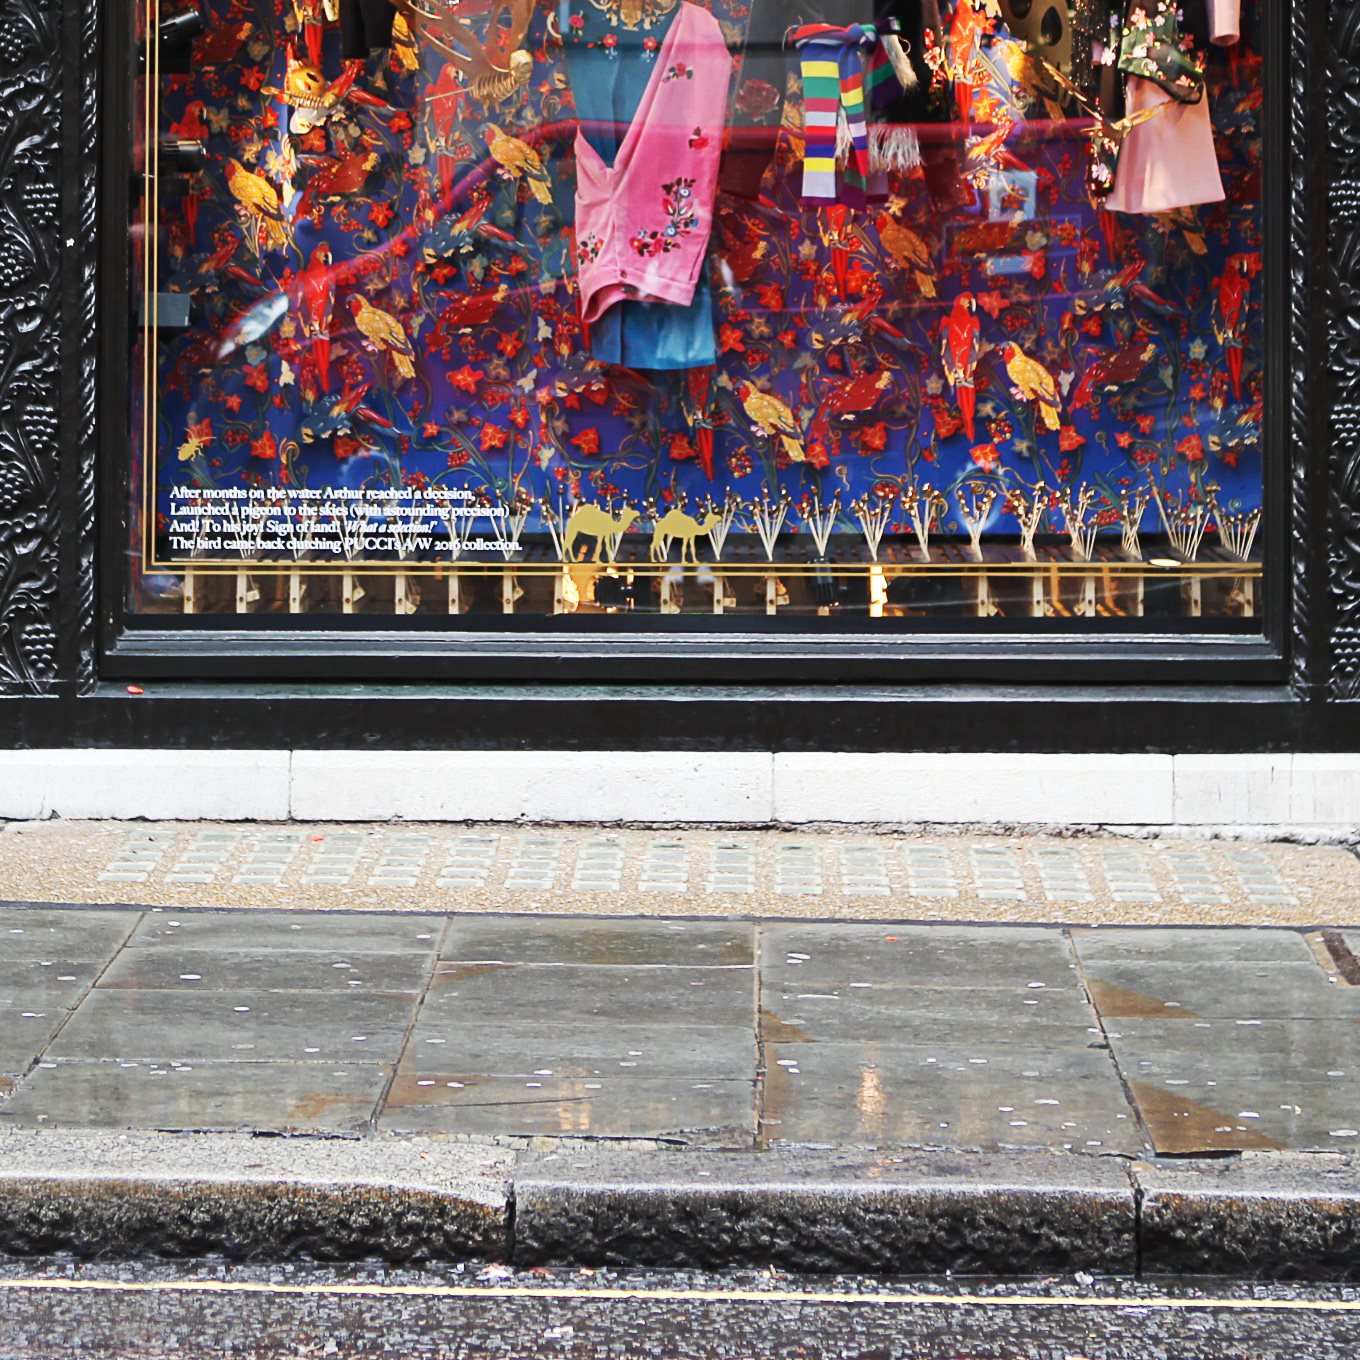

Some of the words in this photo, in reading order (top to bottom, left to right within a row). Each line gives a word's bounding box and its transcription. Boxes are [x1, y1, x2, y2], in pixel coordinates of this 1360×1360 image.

[169, 486, 201, 499] After
[202, 486, 247, 499] months
[248, 488, 265, 499] on
[266, 486, 287, 499] the
[287, 488, 322, 499] water
[323, 486, 365, 499] Arthur
[366, 486, 412, 499] reached
[413, 489, 422, 499] a
[423, 487, 476, 501] decision,
[170, 503, 230, 516] Launched
[231, 506, 240, 516] a
[240, 503, 282, 519] pigeon
[283, 504, 297, 516] to
[297, 503, 318, 516] the
[319, 503, 348, 516] skies
[350, 504, 382, 518] (with
[383, 504, 450, 520] astounding
[451, 504, 510, 520] precision)
[169, 520, 200, 533] And!
[201, 520, 221, 533] To
[222, 520, 240, 533] his
[266, 520, 294, 536] Sign
[296, 520, 311, 533] of
[310, 520, 340, 533] land!
[378, 524, 387, 533] a
[169, 537, 195, 550] The
[196, 537, 222, 550] bird
[222, 540, 256, 550] came
[256, 537, 286, 550] back
[286, 537, 342, 554] clutching
[344, 537, 400, 550] PUCCI's
[402, 537, 433, 552] A/W
[434, 538, 461, 550] 2016
[462, 538, 523, 550] collection.
